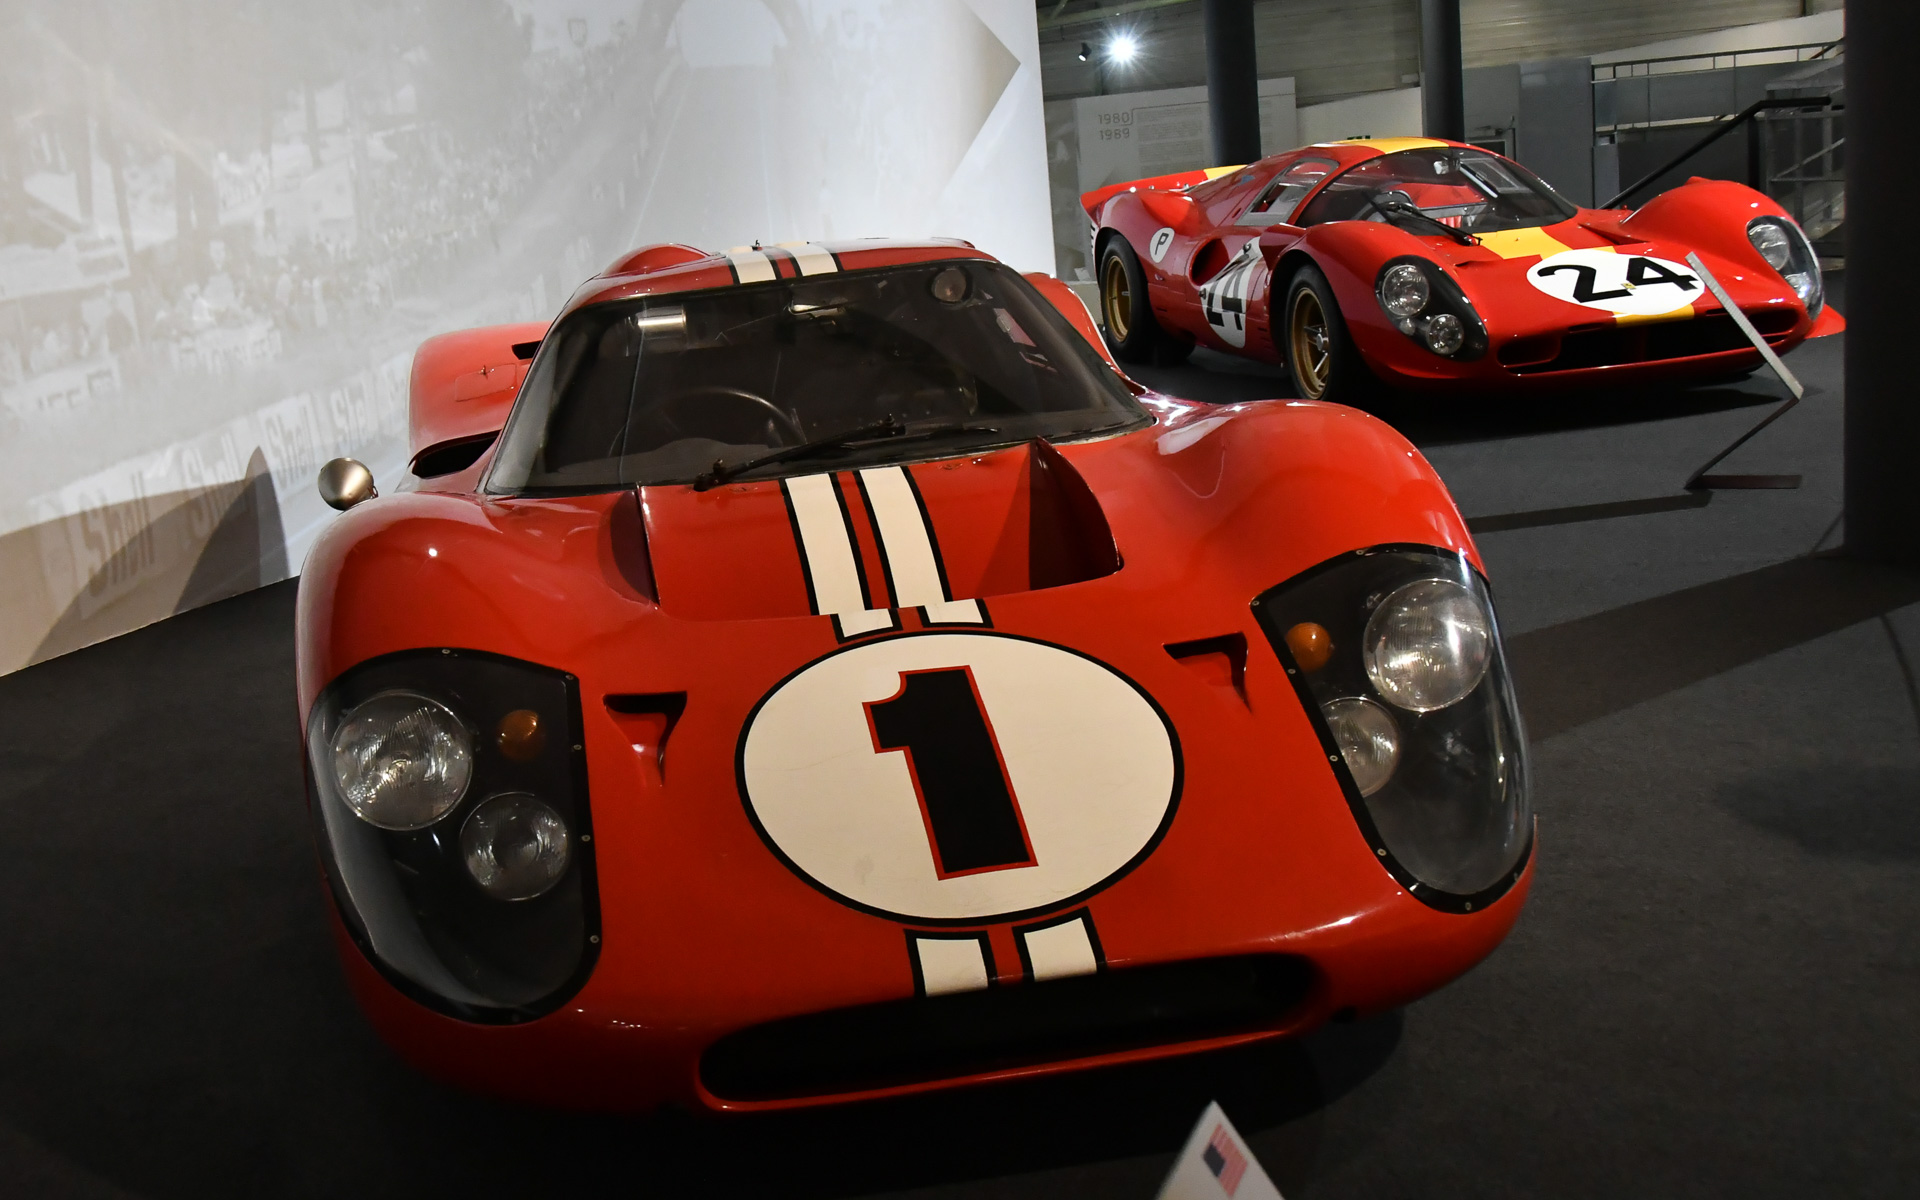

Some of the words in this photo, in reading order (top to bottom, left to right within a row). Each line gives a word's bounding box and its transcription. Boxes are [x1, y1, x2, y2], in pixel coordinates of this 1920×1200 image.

[1098, 112, 1130, 124] 1980
[1100, 128, 1130, 140] 1989
[1155, 233, 1169, 255] P
[1537, 257, 1698, 303] 24
[79, 470, 155, 597] Shell
[862, 665, 1038, 880] 1
